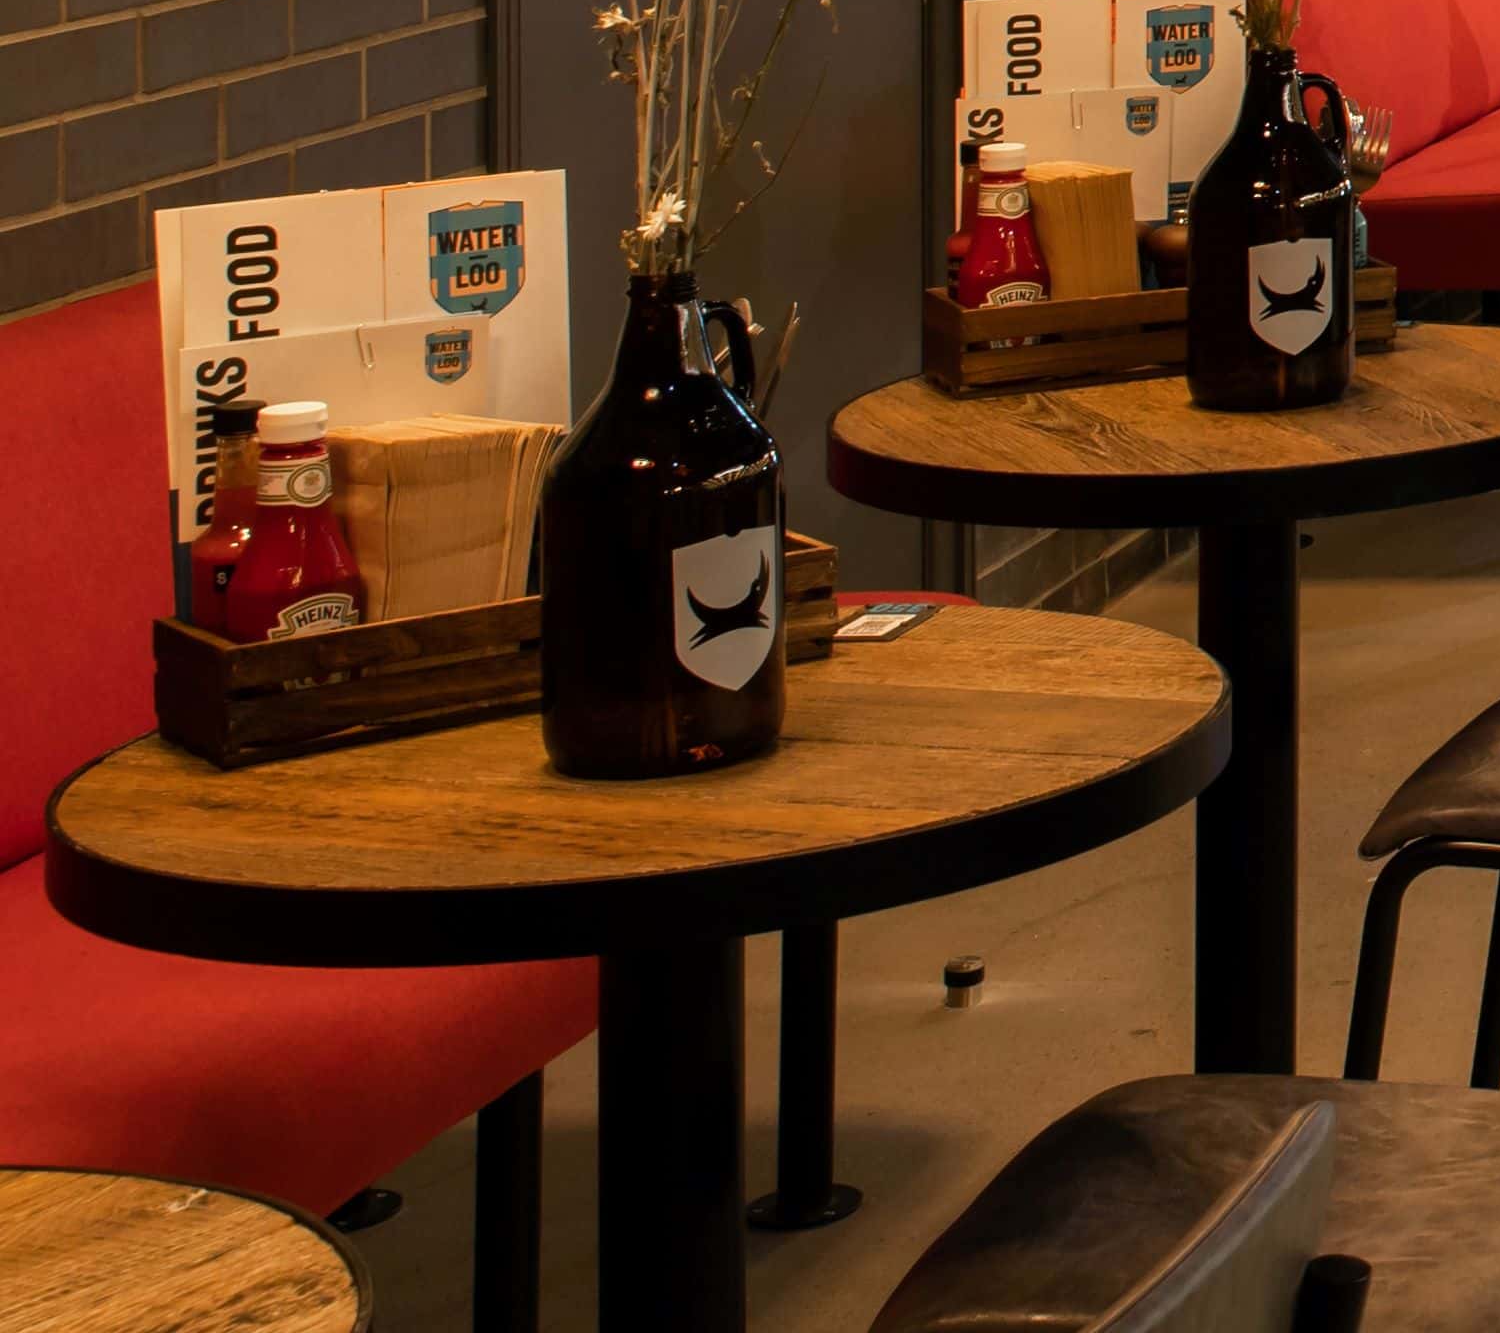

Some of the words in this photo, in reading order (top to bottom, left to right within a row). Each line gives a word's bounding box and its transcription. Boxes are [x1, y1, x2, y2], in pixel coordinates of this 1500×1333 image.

[1152, 21, 1210, 41] WATER
[1007, 14, 1042, 96] FOOD
[1164, 48, 1197, 68] LOO
[436, 223, 519, 255] WATER
[226, 225, 281, 342] FOOD
[455, 261, 501, 289] LOO
[999, 290, 1035, 305] HEINZ
[430, 339, 469, 354] WATER
[436, 356, 461, 370] LOO
[295, 603, 344, 629] HEINZ
